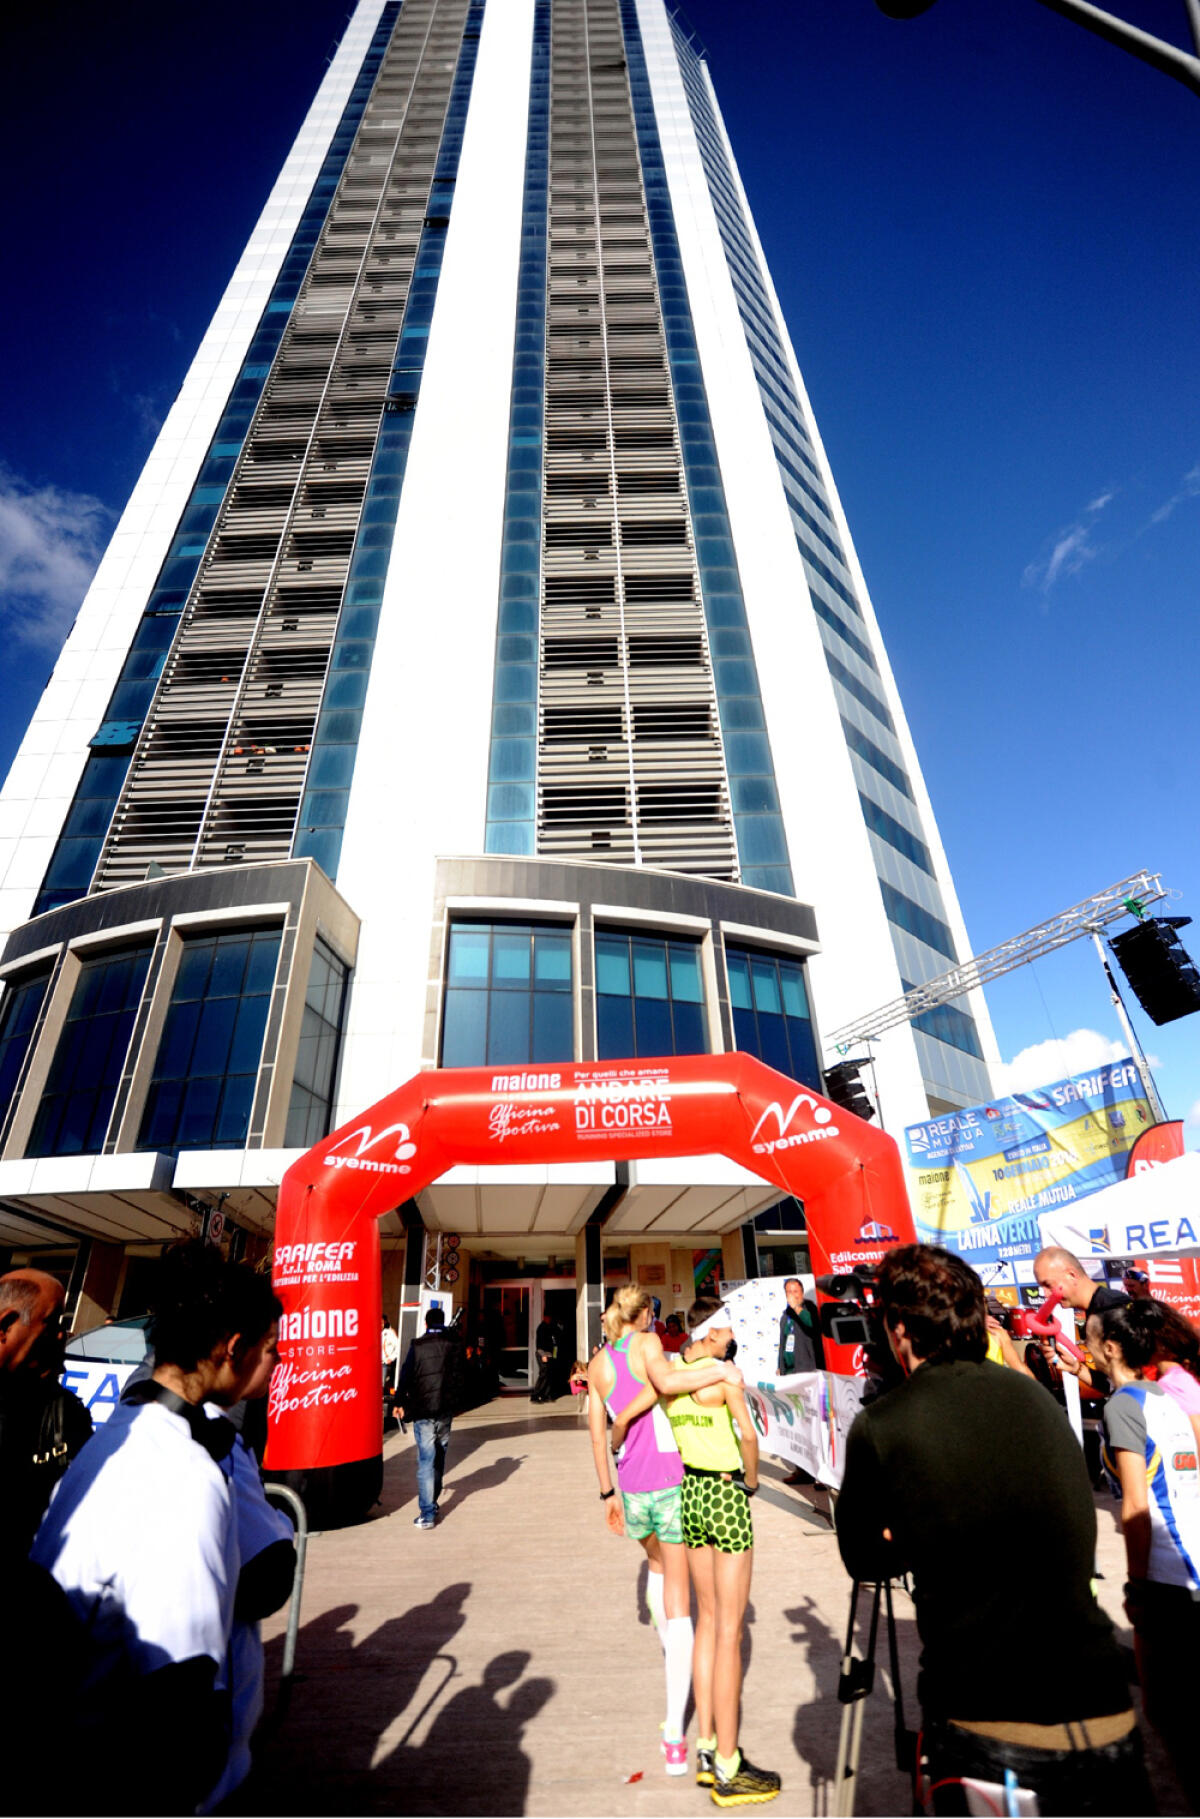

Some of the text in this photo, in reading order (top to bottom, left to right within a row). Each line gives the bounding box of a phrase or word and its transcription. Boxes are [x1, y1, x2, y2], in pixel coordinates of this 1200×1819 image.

[491, 1073, 562, 1092] maione
[592, 1070, 617, 1080] quelli
[619, 1069, 635, 1077] che
[638, 1068, 669, 1076] amano
[1052, 1065, 1137, 1107] SARIFER
[573, 1078, 672, 1106] ANDARE
[489, 1103, 556, 1123] Officina
[575, 1102, 672, 1129] DI CORSA
[928, 1112, 980, 1138] REALE
[488, 1118, 561, 1143] Sportiva
[752, 1126, 839, 1154] syemme
[933, 1128, 984, 1148] MUTUA
[323, 1155, 411, 1174] syemme
[1008, 1184, 1077, 1214] REALE MUTUA
[274, 1242, 354, 1266] SARIFER
[302, 1274, 317, 1283] PER
[306, 1260, 341, 1273] ROMA
[288, 1344, 335, 1357] STORE
[271, 1362, 352, 1391] Officina
[268, 1382, 358, 1424] Sportiva
